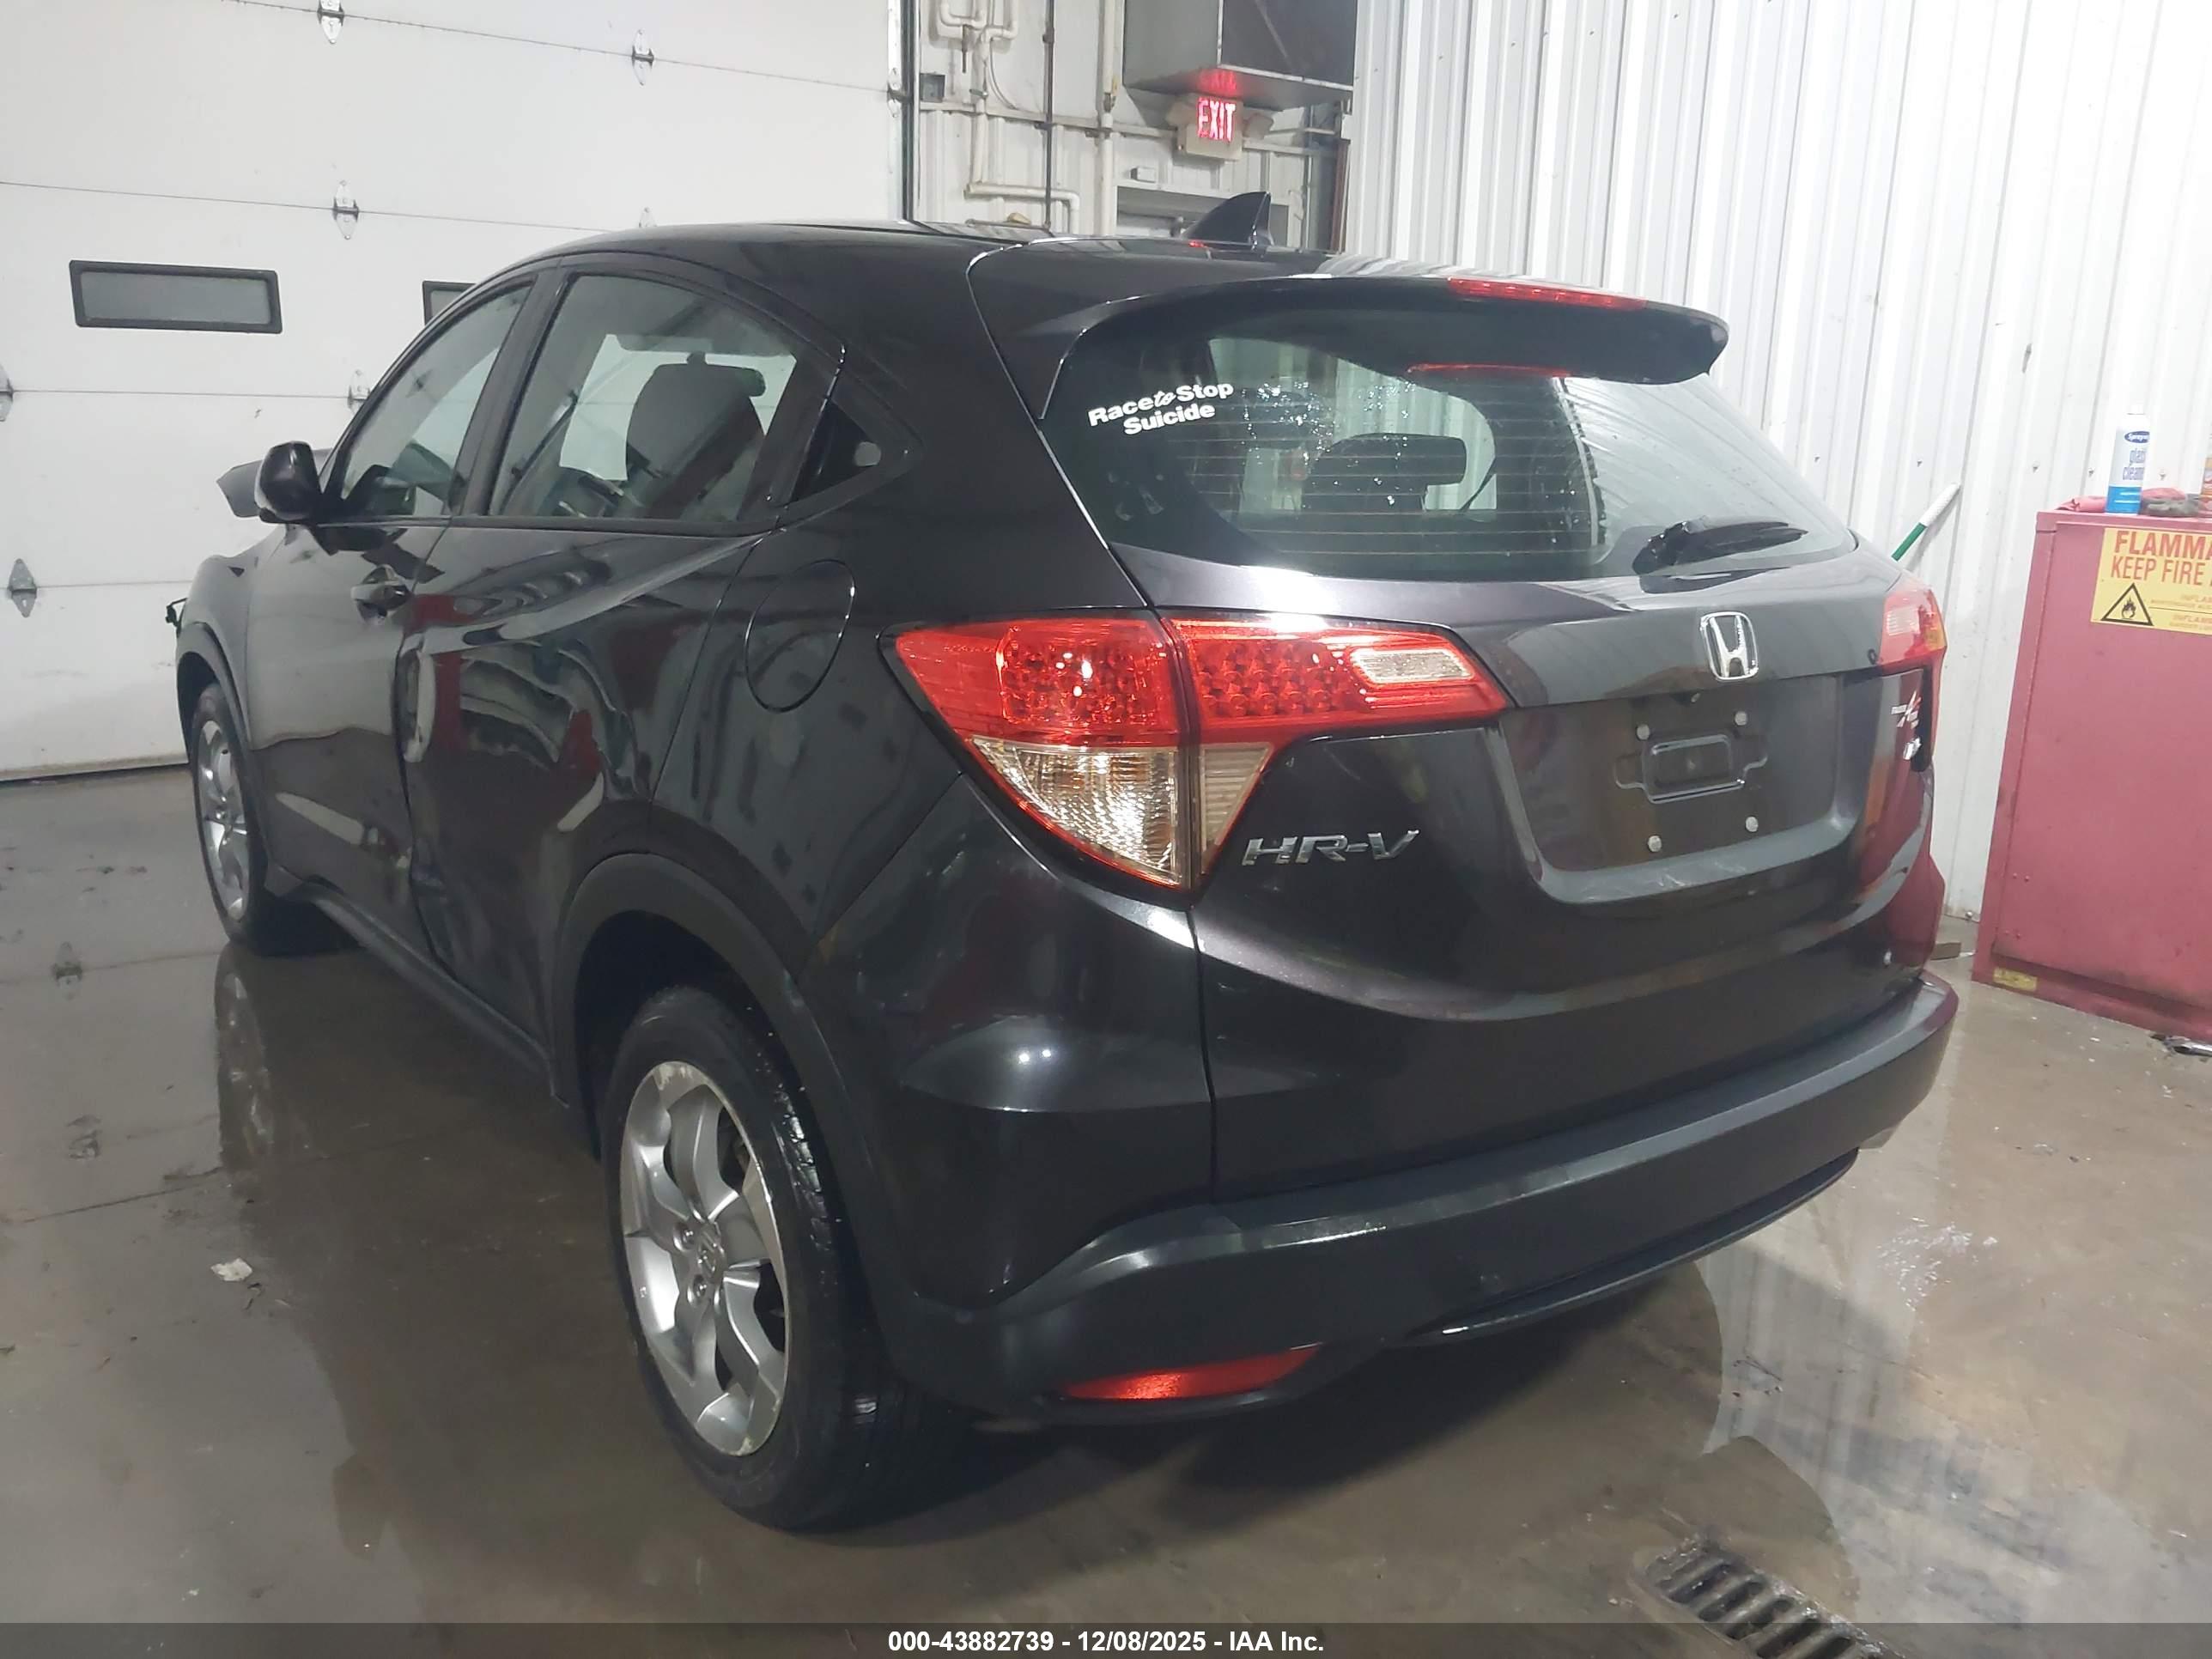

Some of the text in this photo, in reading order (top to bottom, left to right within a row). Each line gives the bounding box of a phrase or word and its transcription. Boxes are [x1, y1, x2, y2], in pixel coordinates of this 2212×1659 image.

[1197, 98, 1237, 142] EXIT
[1087, 383, 1235, 427] Race to Stop
[1122, 403, 1216, 435] Suicide
[2110, 555, 2157, 581] KEEP
[2160, 559, 2207, 586] FIRE
[1241, 830, 1420, 866] HR-V
